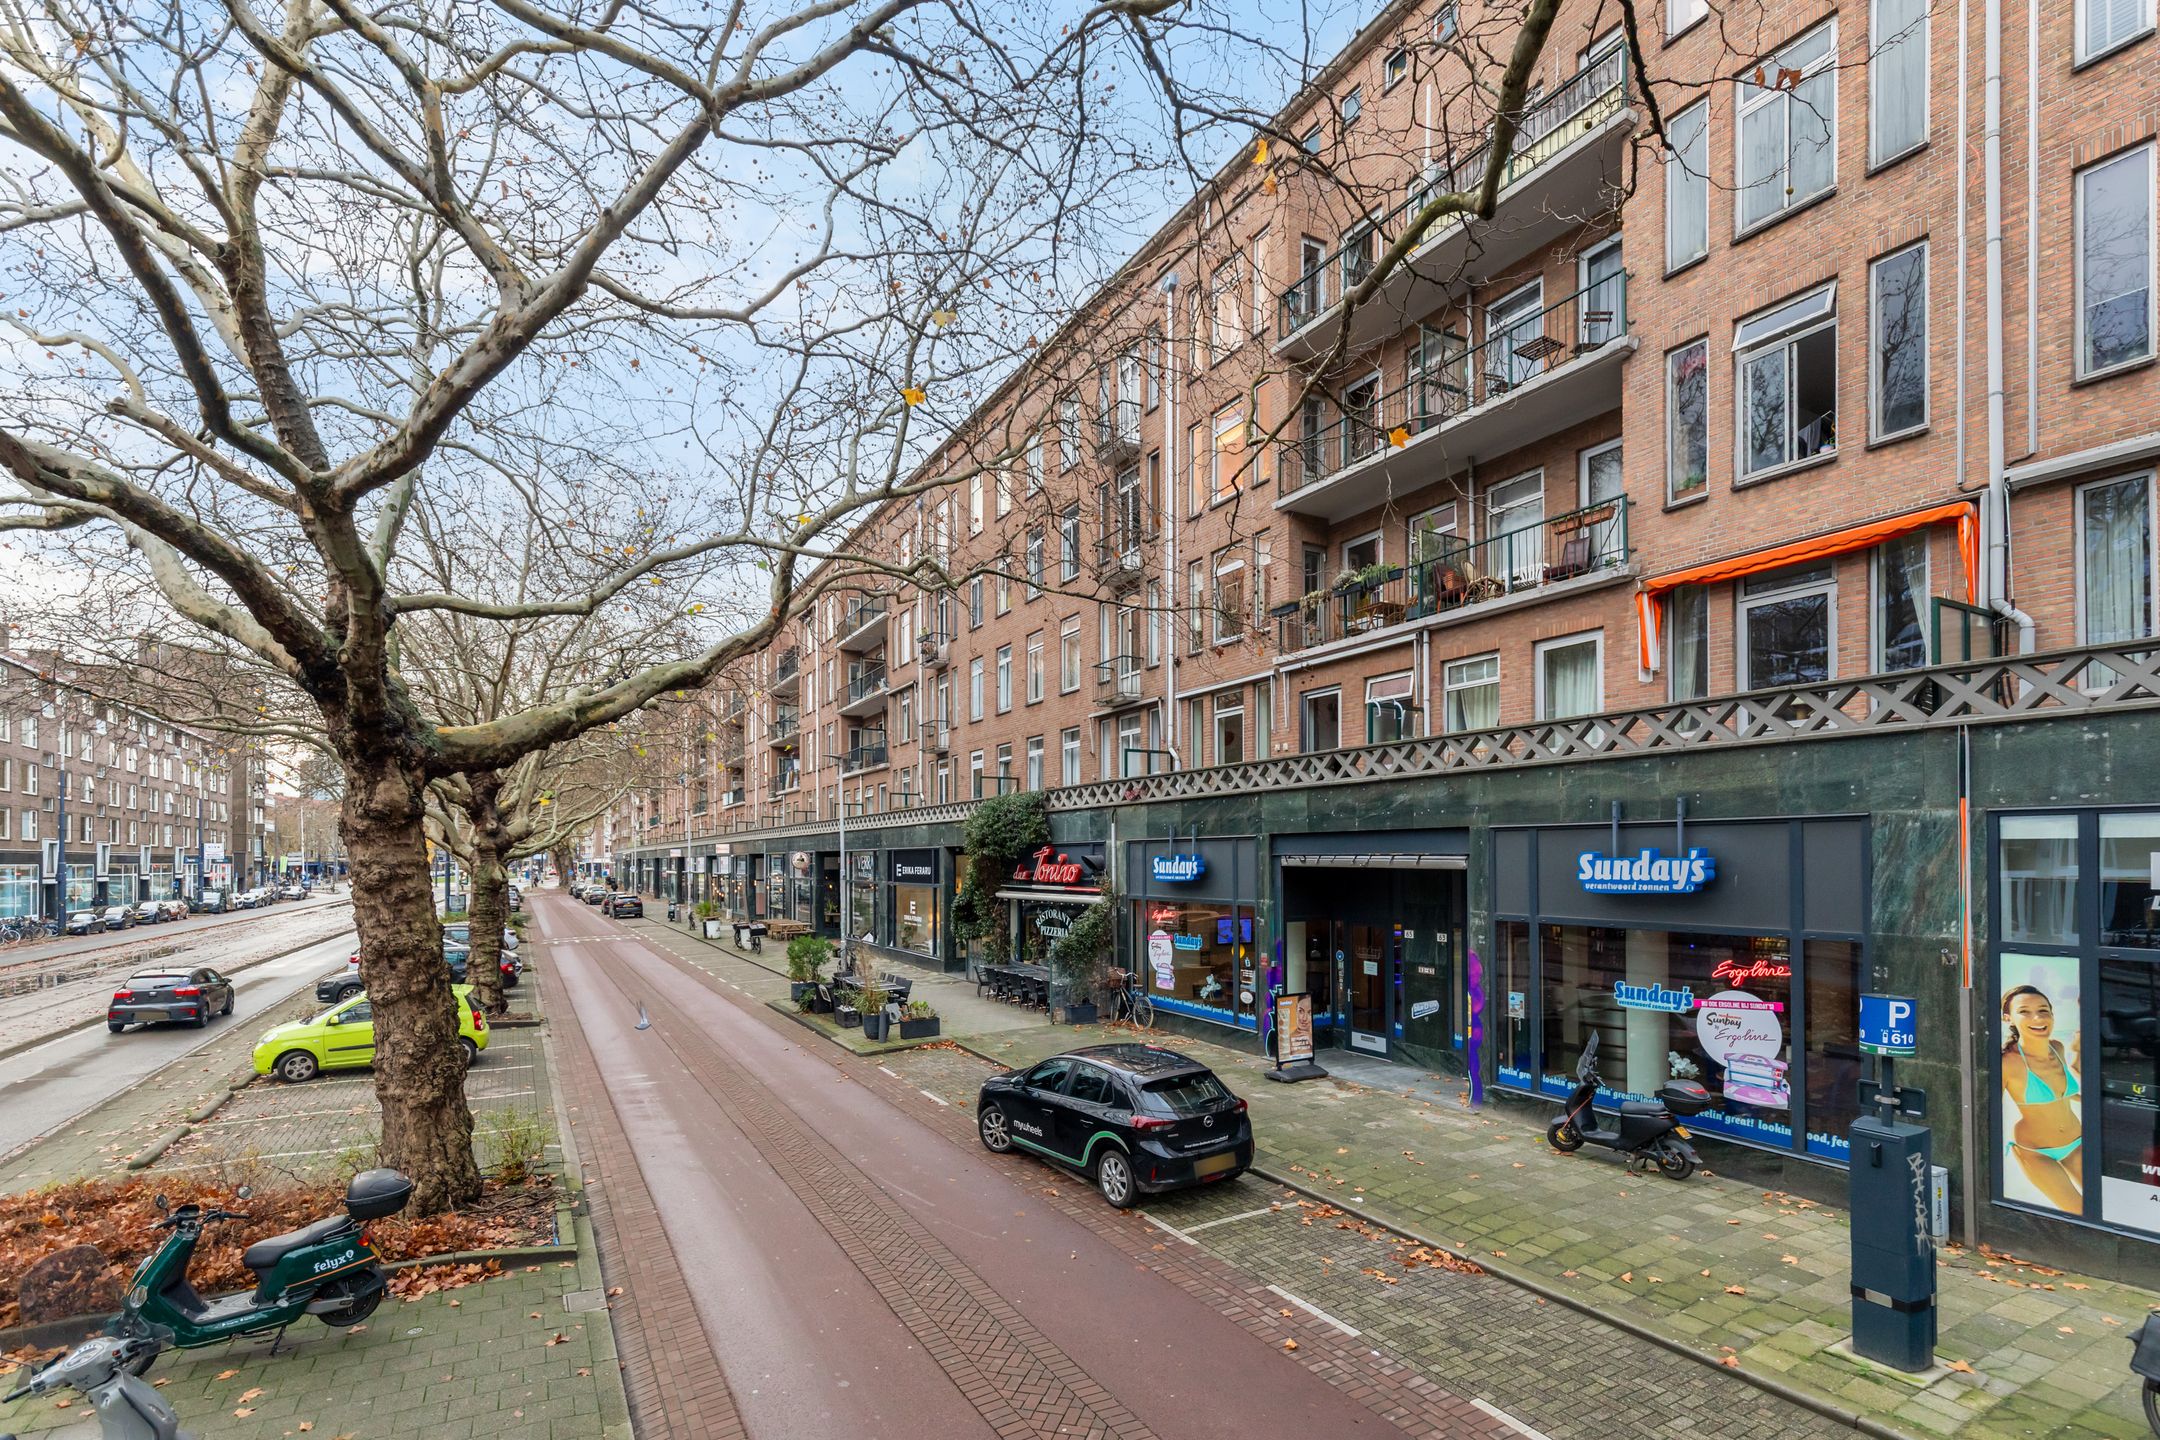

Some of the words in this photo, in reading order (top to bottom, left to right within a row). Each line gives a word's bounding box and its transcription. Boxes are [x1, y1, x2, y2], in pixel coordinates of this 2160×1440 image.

[902, 866, 914, 875] ERIKA
[914, 866, 931, 875] FERARU
[1033, 845, 1080, 882] Tonino
[1153, 855, 1198, 879] Sunday's
[1579, 850, 1705, 890] Sunday's
[1040, 925, 1069, 937] PIZZERIA
[1712, 960, 1792, 987] Ergoline
[1614, 981, 1693, 1011] Sunday's
[1889, 1001, 1910, 1028] P
[1714, 1027, 1776, 1047] Ergoline
[1891, 1033, 1914, 1044] 610
[1013, 1119, 1043, 1137] mywheels
[1696, 1108, 1724, 1120] eelin'
[1724, 1114, 1754, 1127] great!
[1758, 1119, 1792, 1136] lookin
[1806, 1132, 1830, 1146] ood,
[313, 1254, 347, 1273] felyx
